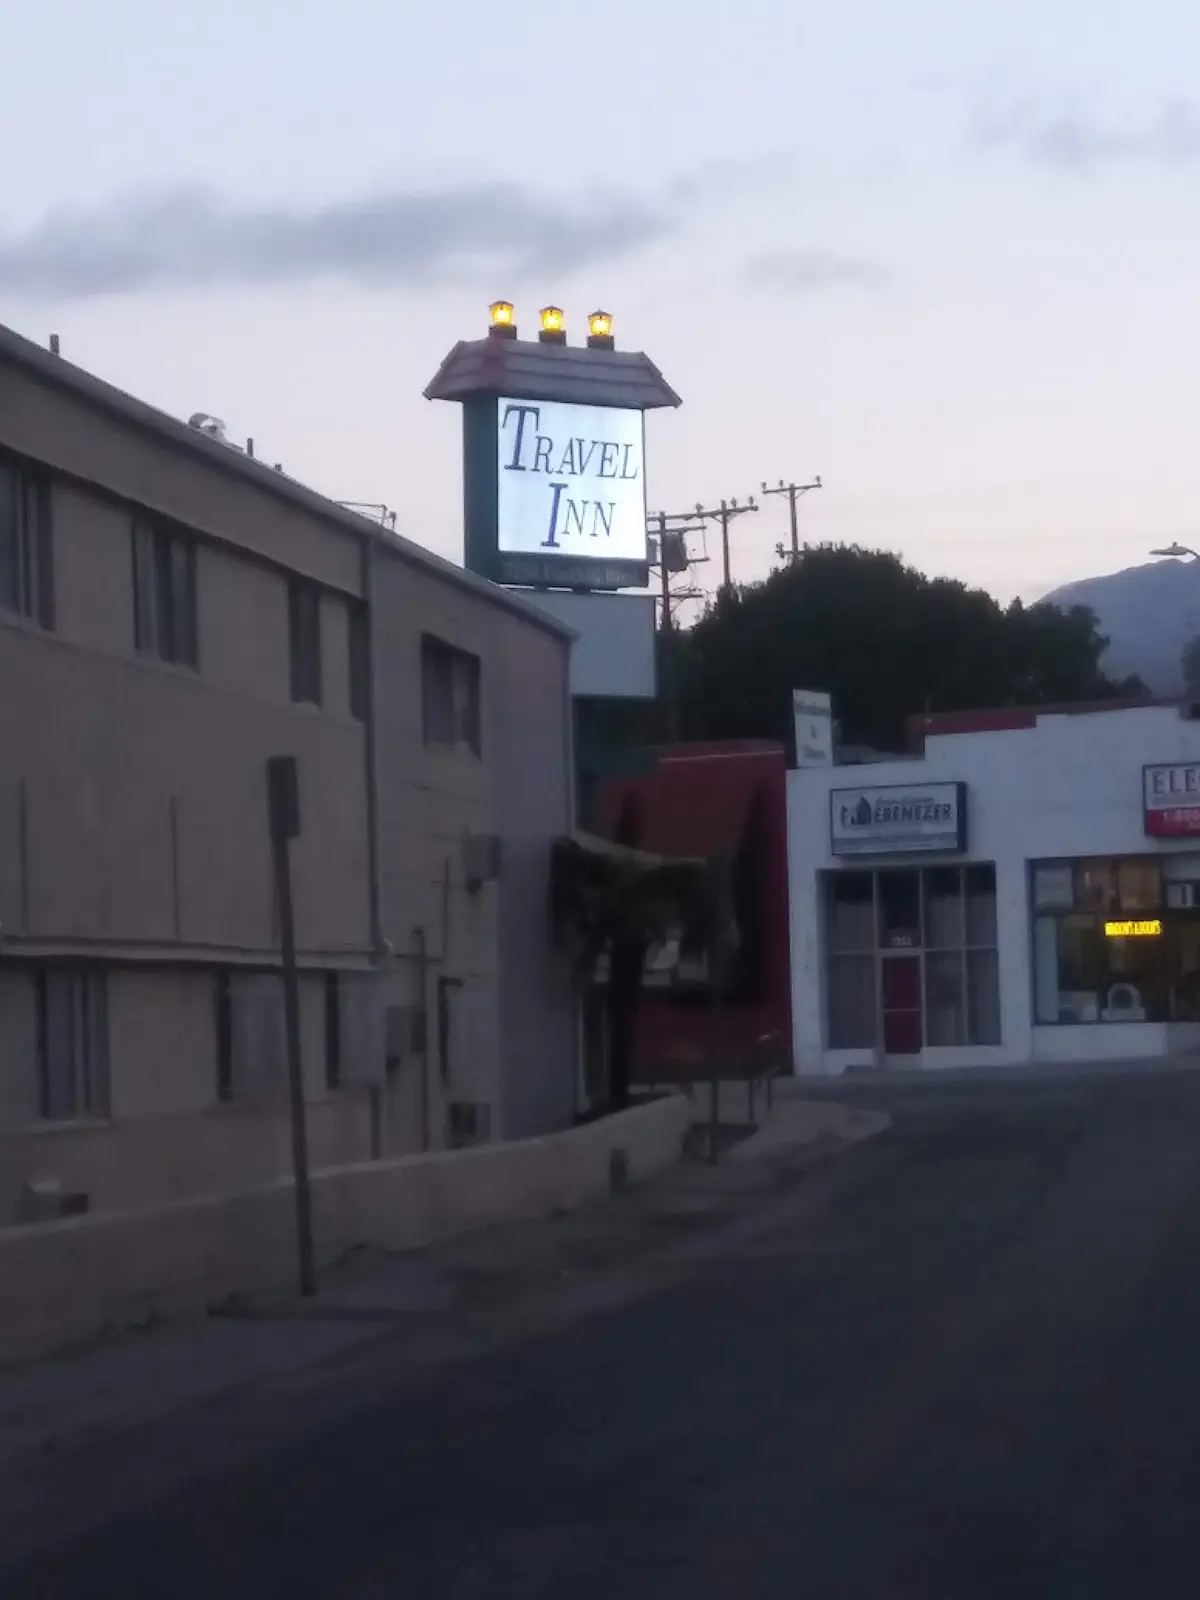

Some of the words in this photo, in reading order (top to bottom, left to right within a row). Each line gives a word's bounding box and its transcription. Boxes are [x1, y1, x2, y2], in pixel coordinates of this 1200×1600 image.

[500, 404, 638, 480] TRAVEL
[540, 482, 616, 548] INN
[1151, 769, 1200, 795] ELE
